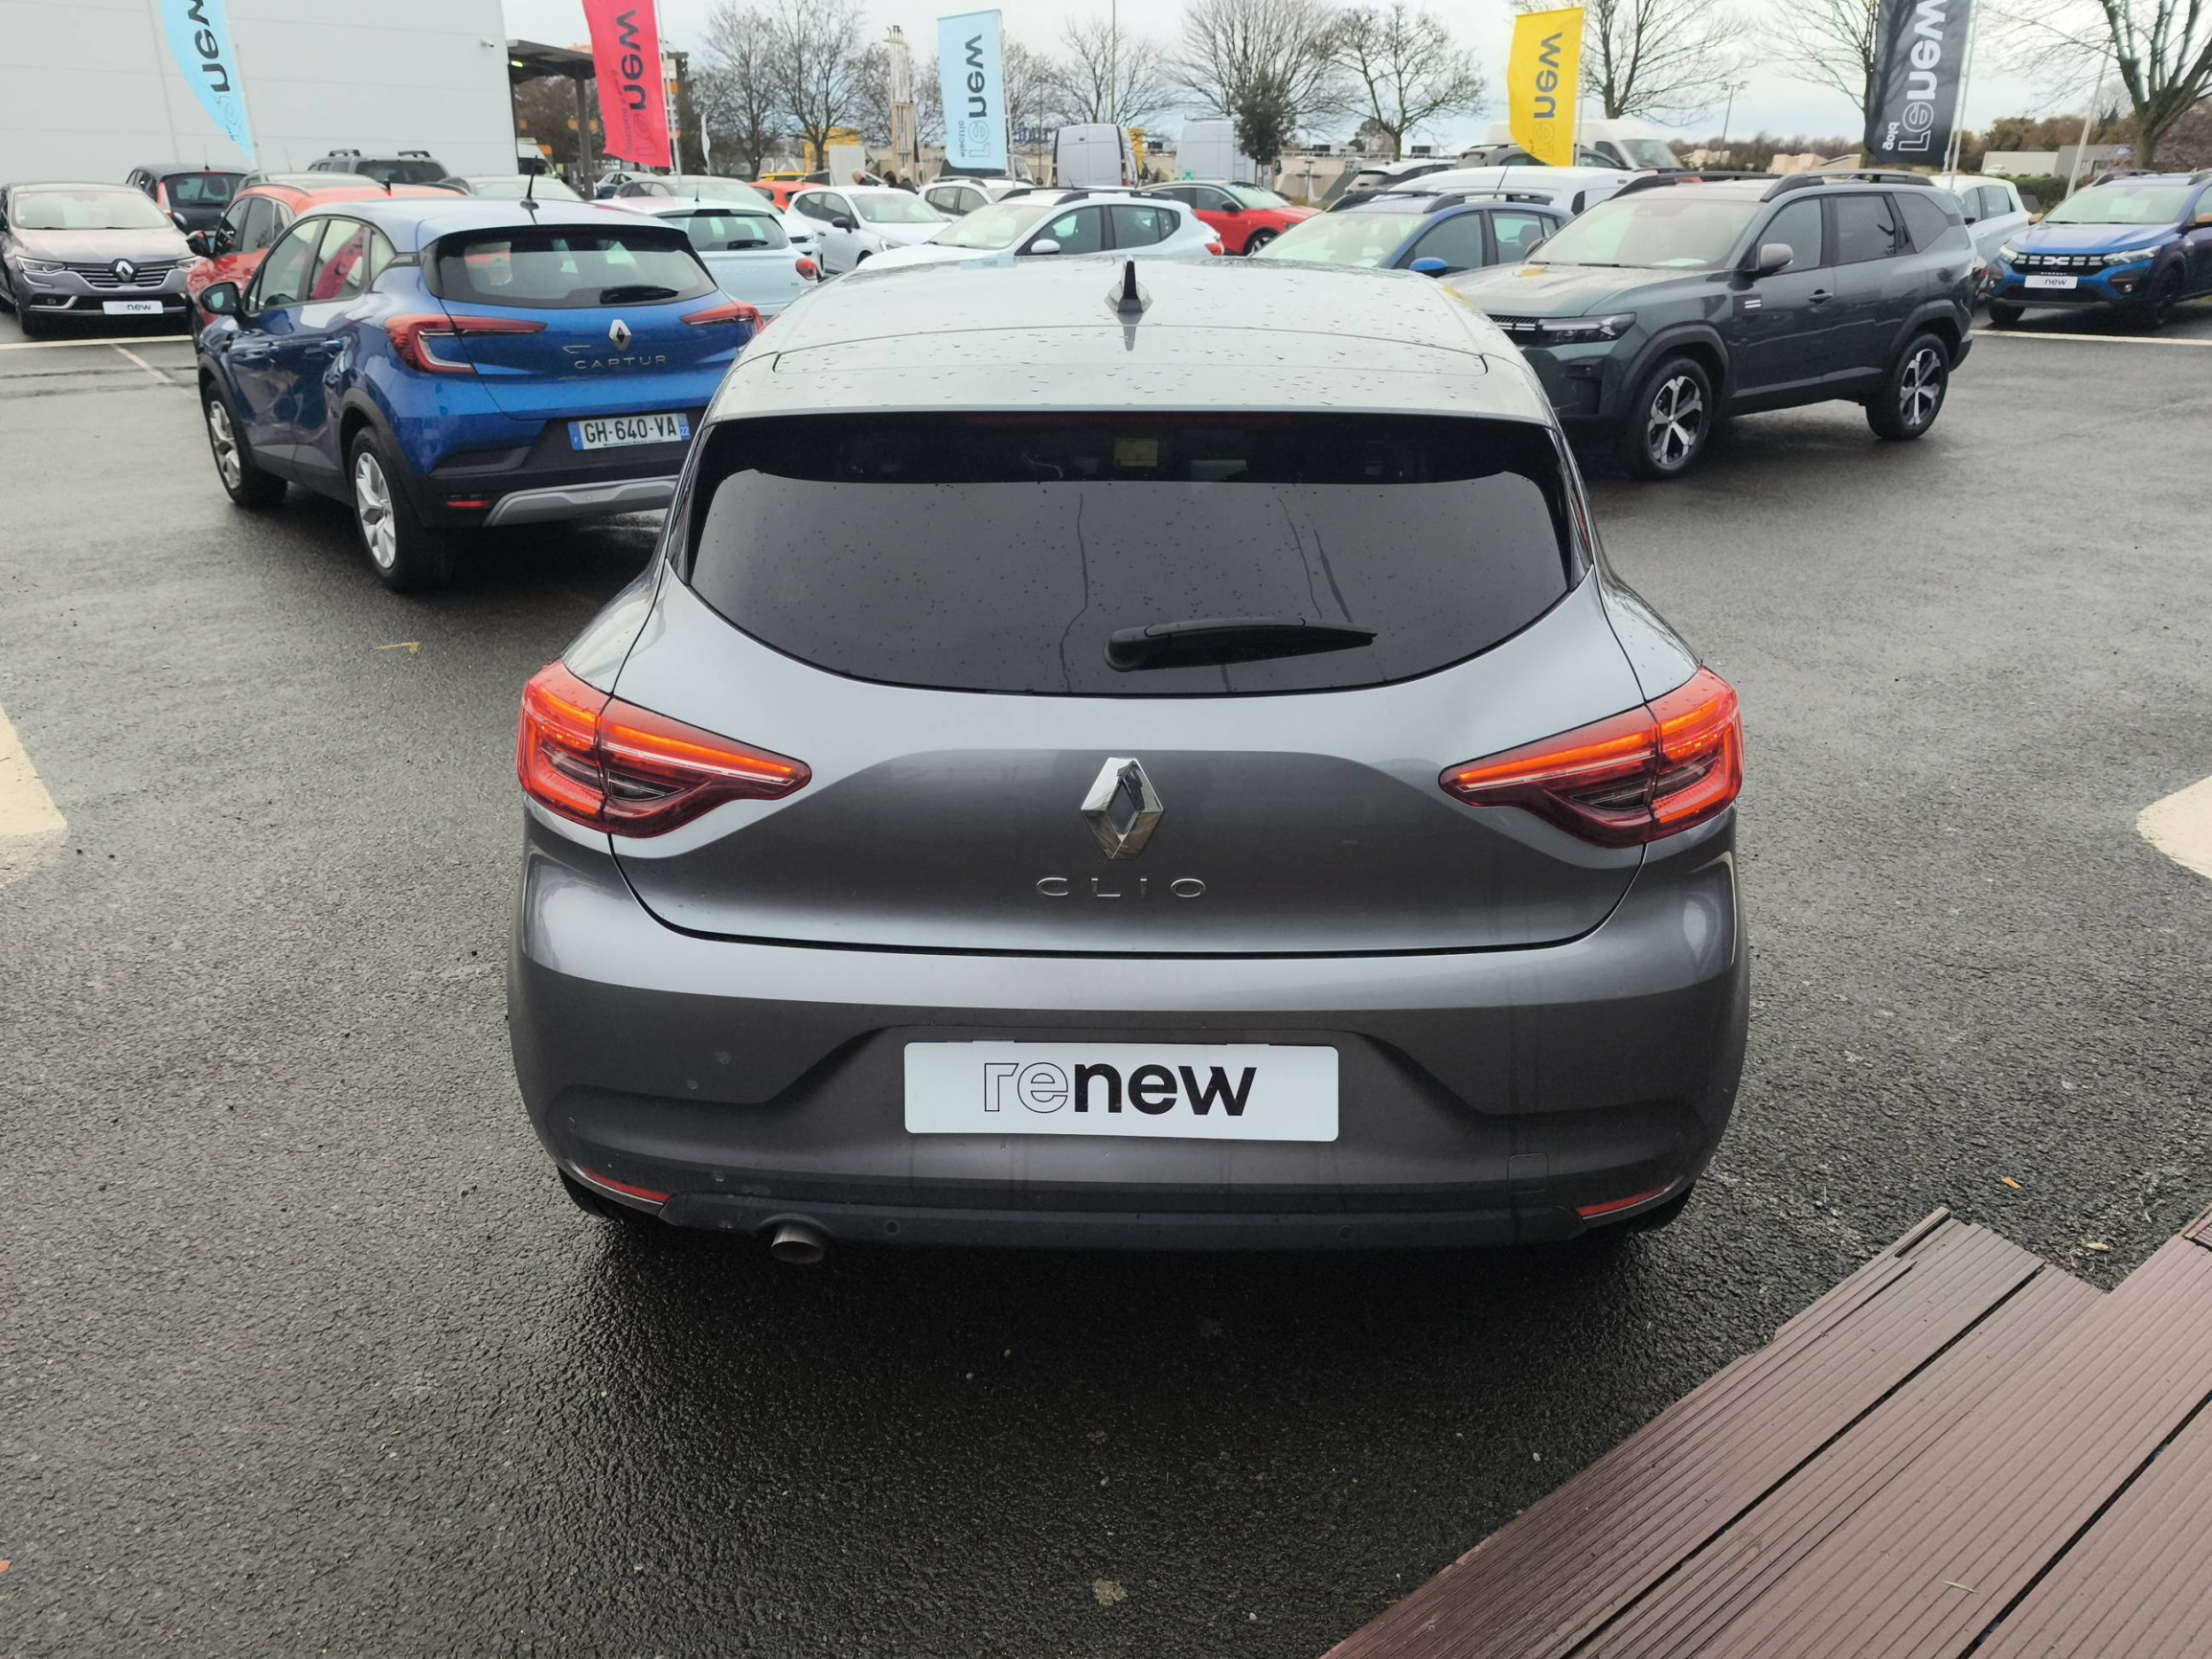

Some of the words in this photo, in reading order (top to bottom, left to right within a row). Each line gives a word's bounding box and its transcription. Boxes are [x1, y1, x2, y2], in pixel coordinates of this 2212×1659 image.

[574, 355, 667, 370] CAPTUR
[583, 416, 677, 443] GH-640-VA
[1036, 877, 1207, 898] CLIO
[984, 1061, 1257, 1117] renew
